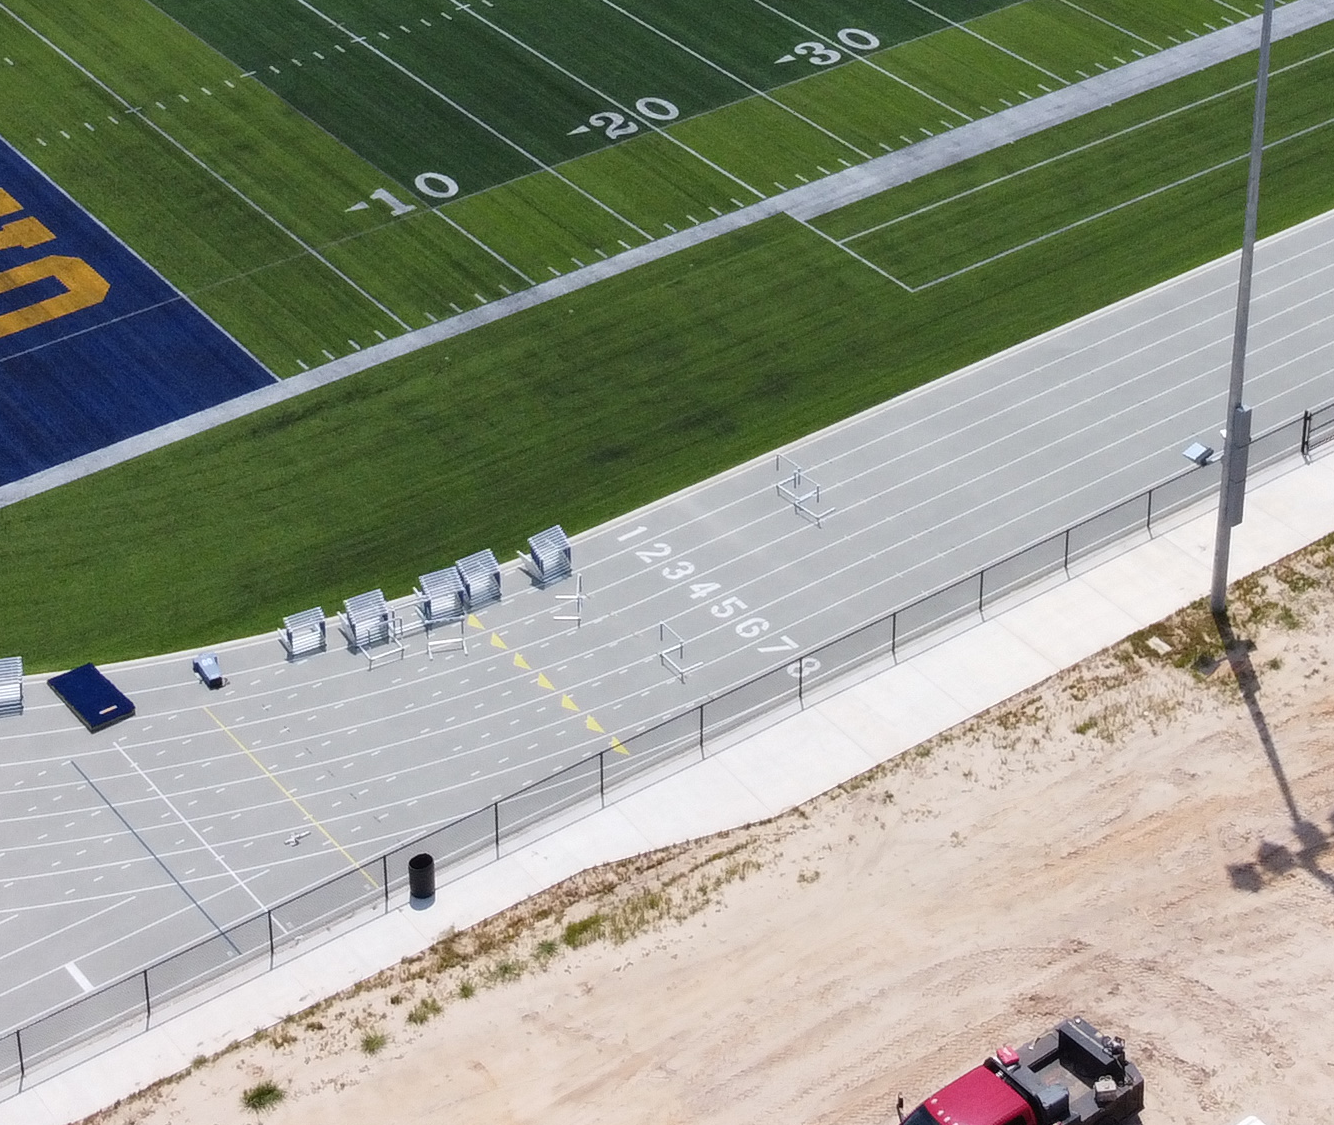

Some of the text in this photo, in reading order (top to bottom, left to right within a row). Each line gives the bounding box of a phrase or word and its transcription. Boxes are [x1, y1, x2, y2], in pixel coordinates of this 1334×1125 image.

[793, 27, 881, 68] 30
[589, 96, 681, 141] 20
[369, 171, 460, 218] 10
[617, 526, 821, 678] 1 2 3 4 5 6 7 8
